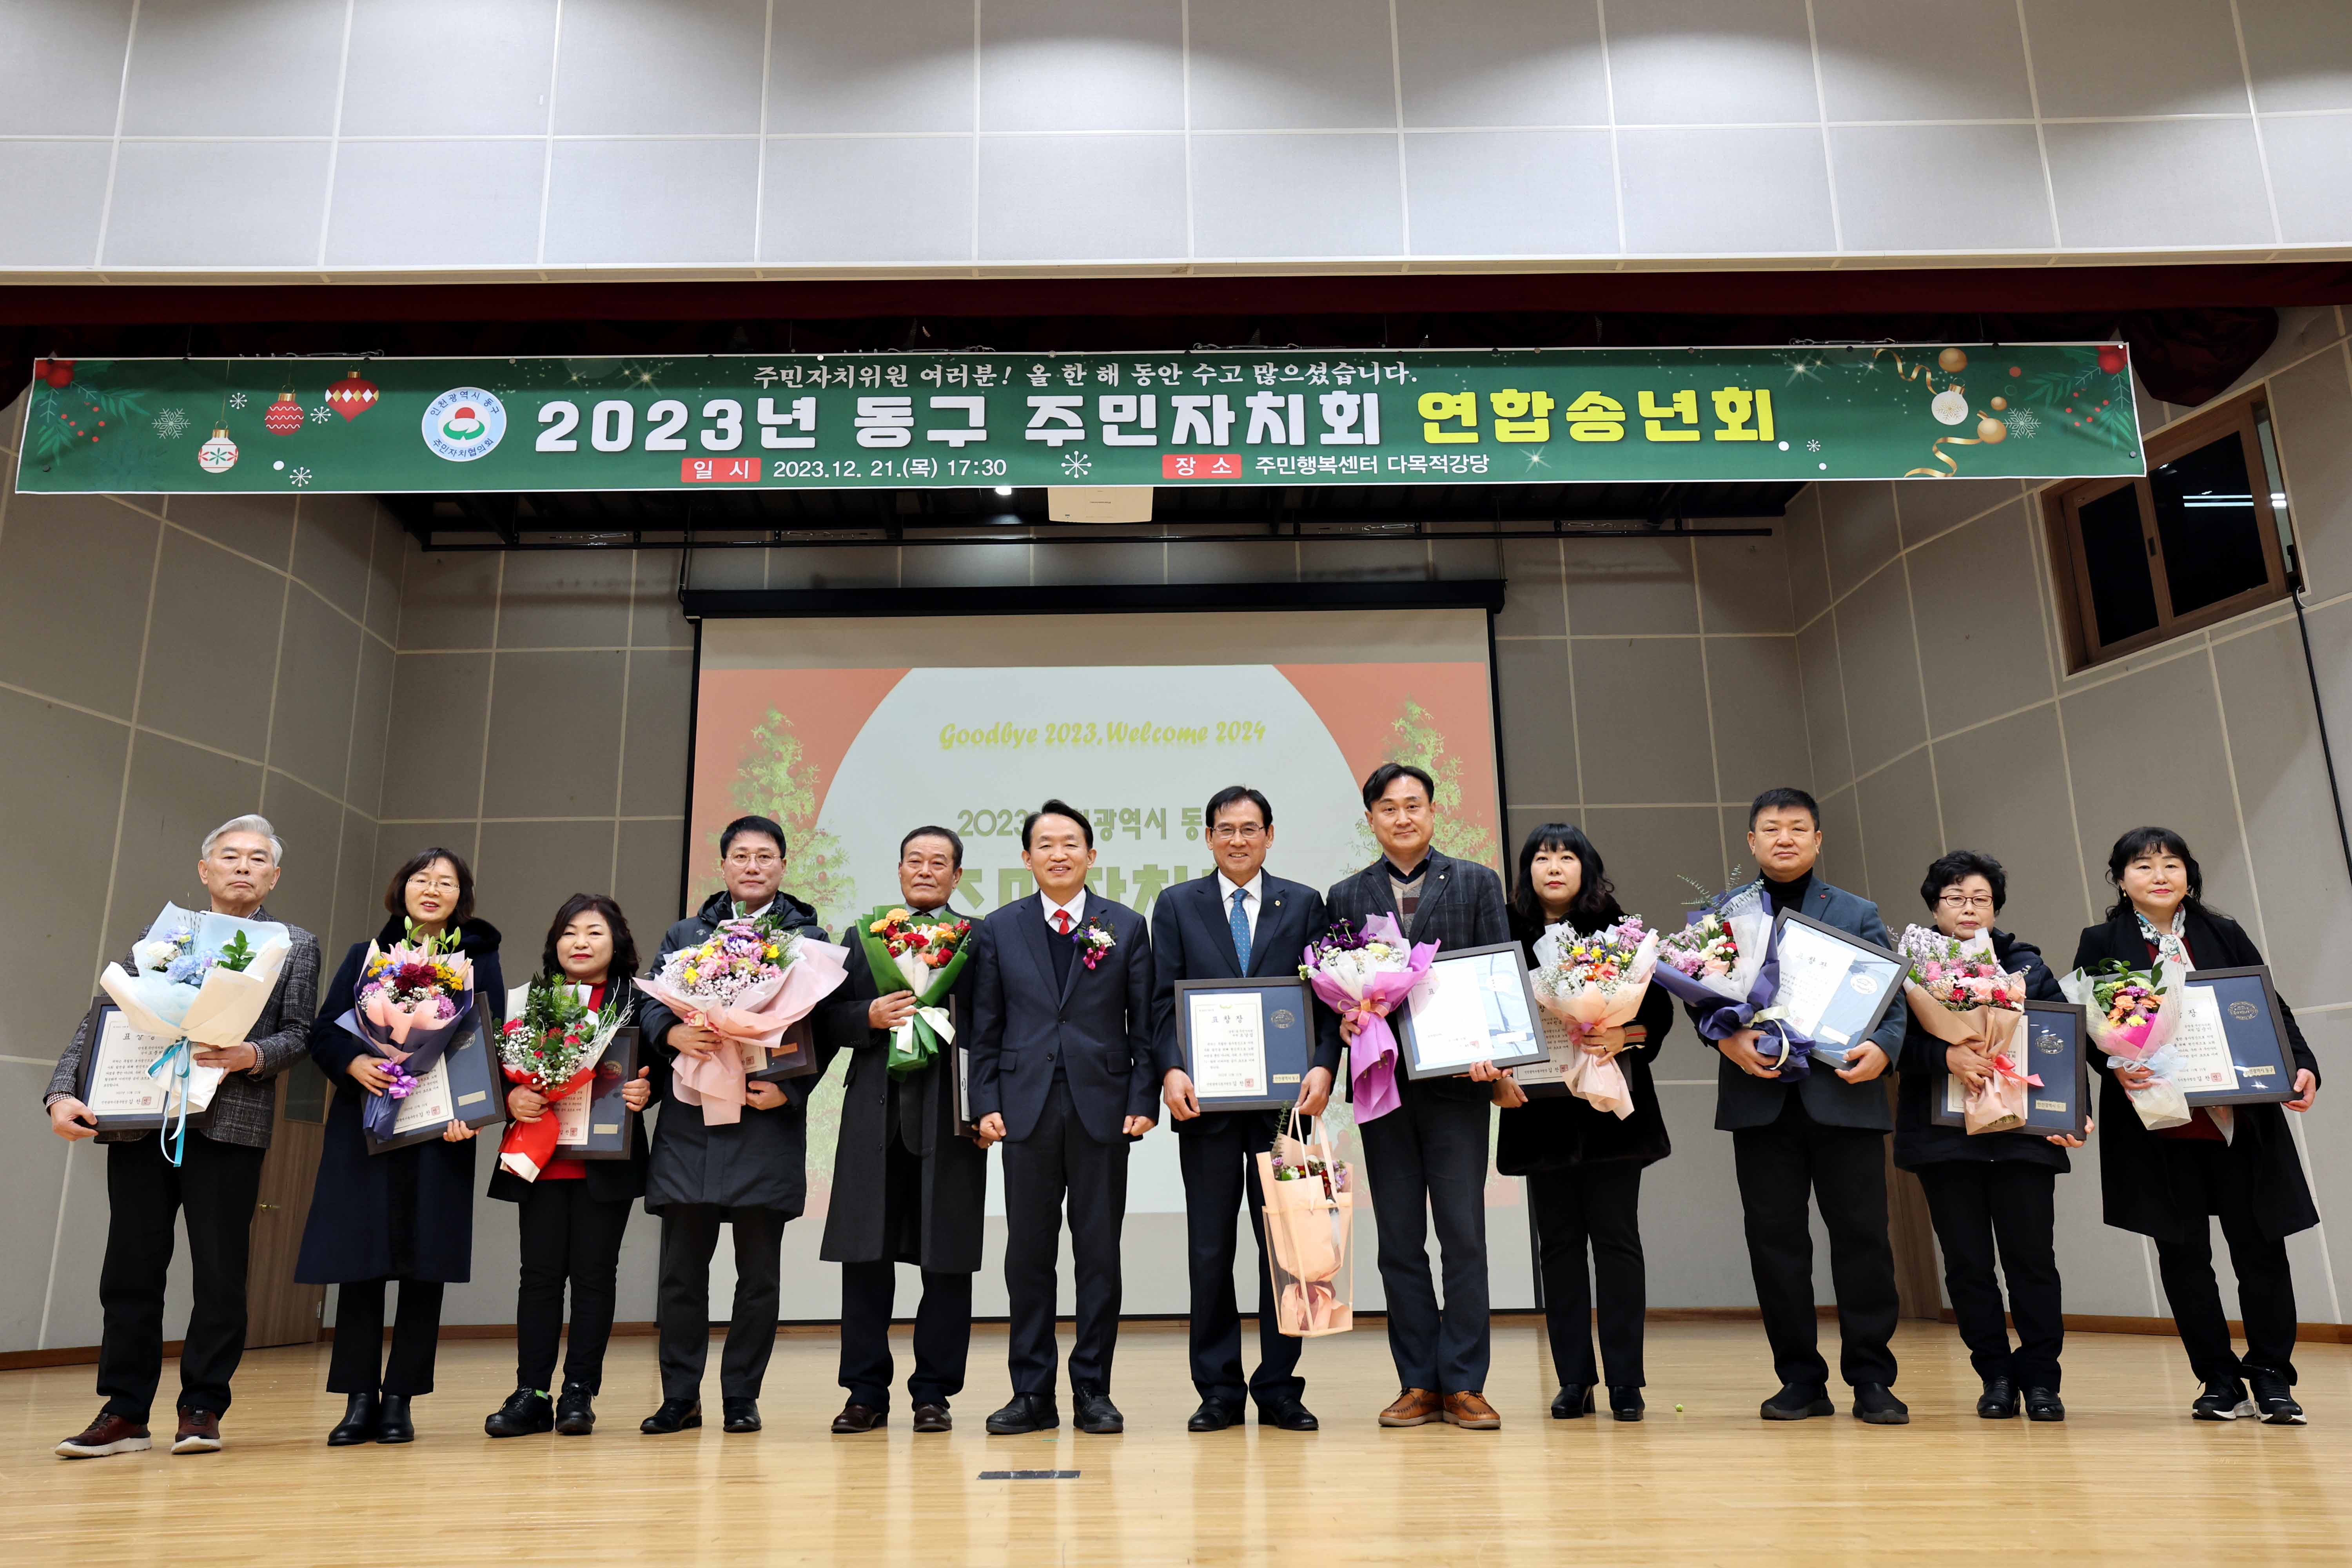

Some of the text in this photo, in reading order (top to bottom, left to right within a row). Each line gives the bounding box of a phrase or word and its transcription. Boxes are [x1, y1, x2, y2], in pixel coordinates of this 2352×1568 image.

[753, 361, 1417, 390] 주민자치위원 여러분! 올 한 해 동안 수고 많으셨습니다.
[430, 390, 499, 416] 인천광역시 동구
[535, 387, 1775, 452] 2023년 동구 주민자치회 연합송년회
[432, 438, 494, 457] 주민자치협의회
[947, 459, 1007, 476] 17:30
[1255, 454, 1490, 475] 주민행복센터 다목적강당
[940, 721, 1038, 750] Goodbye
[1216, 720, 1266, 743] 2024
